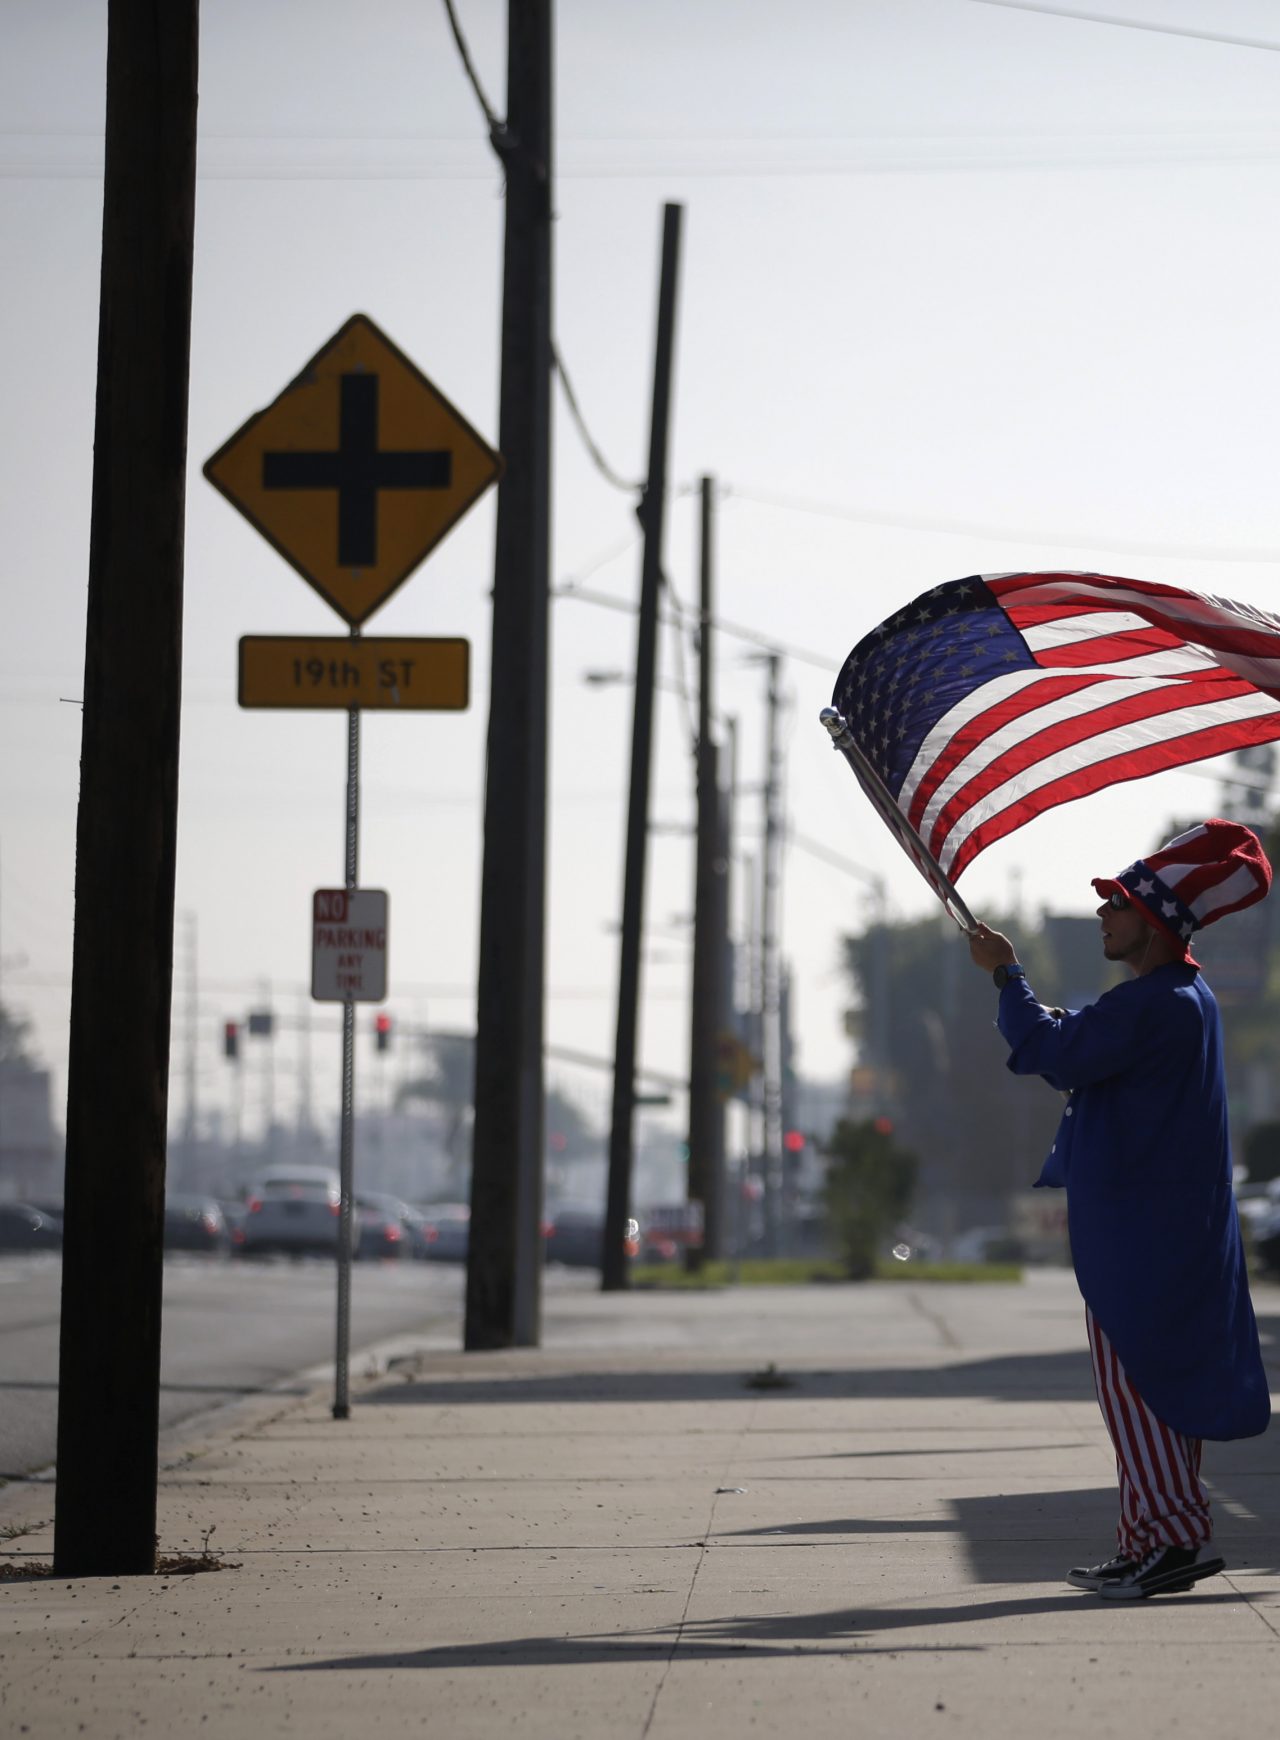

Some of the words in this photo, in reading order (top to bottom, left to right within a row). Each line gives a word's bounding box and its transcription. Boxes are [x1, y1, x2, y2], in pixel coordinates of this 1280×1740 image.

[293, 657, 360, 688] 19th
[379, 658, 416, 688] ST
[317, 892, 344, 919] NO
[316, 928, 385, 951] PARKING
[337, 954, 364, 969] ANY
[336, 973, 364, 990] TIME
